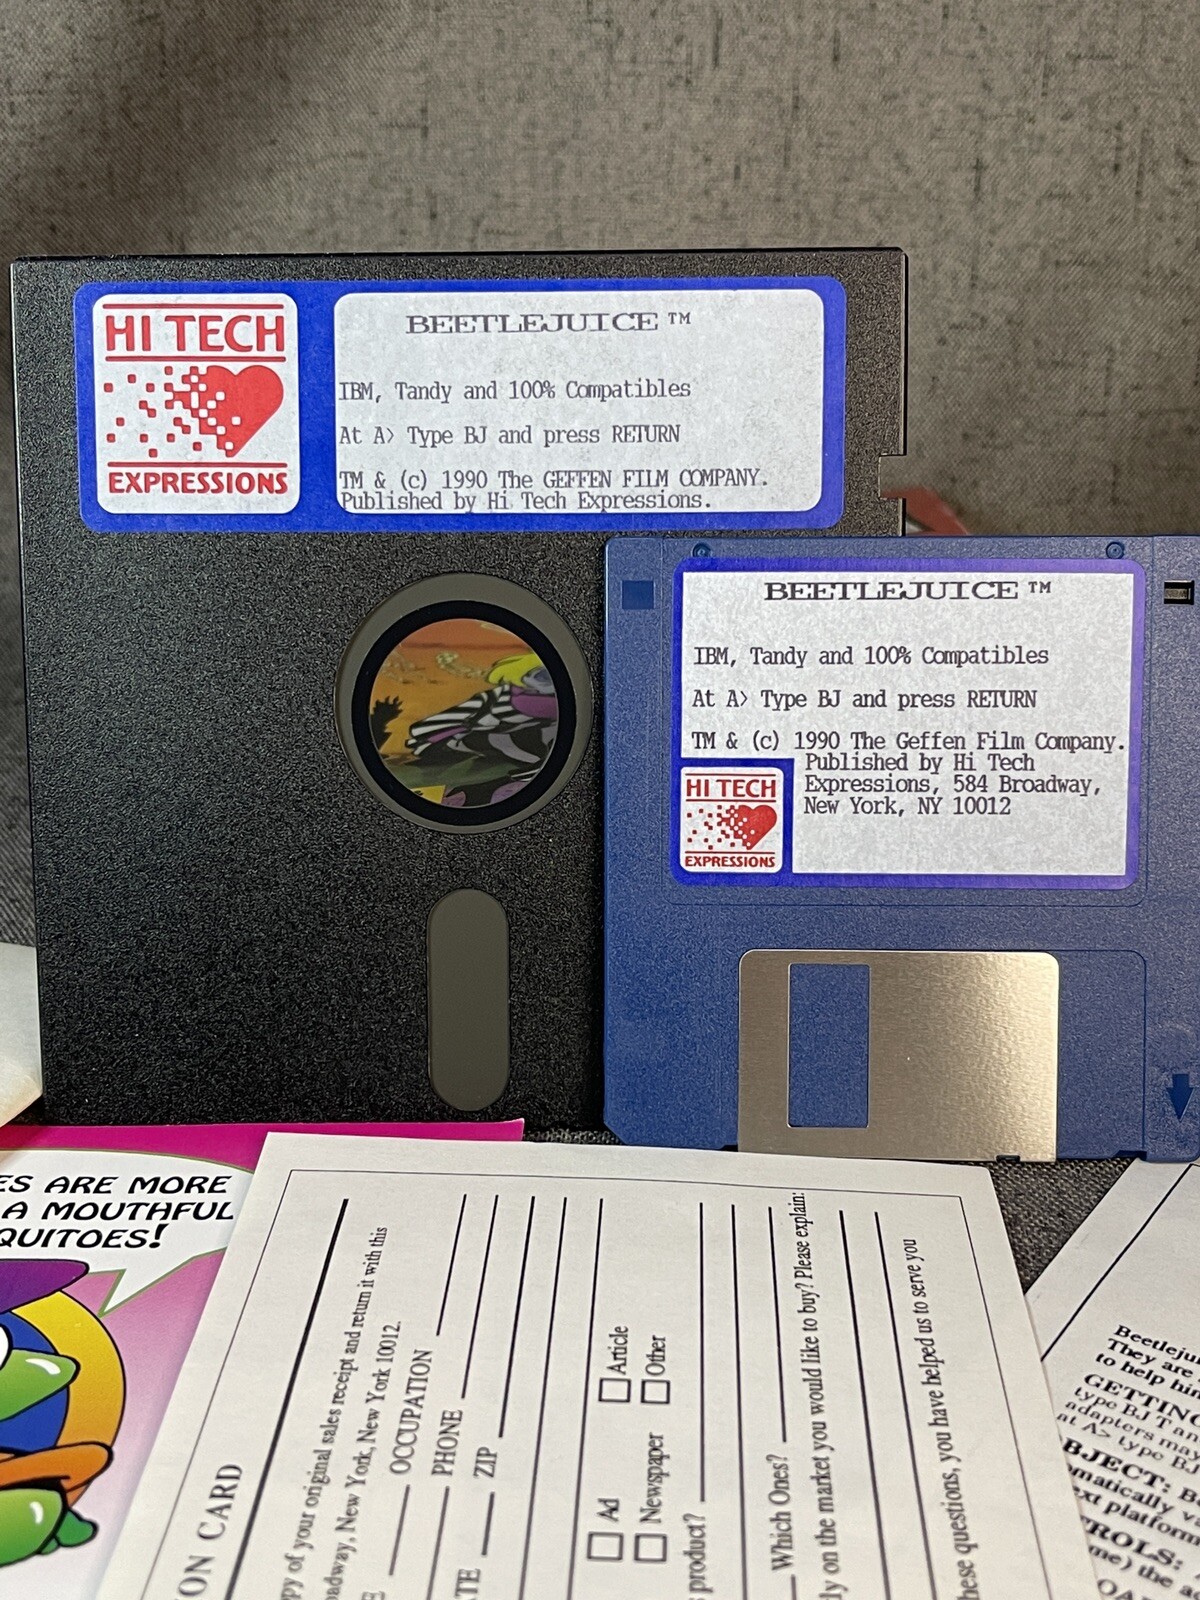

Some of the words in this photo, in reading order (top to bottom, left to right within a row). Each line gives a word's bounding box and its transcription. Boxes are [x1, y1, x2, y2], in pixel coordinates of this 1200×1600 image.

[106, 315, 151, 352] HI
[165, 314, 285, 352] TECH
[406, 313, 660, 334] BEETLEJUICE
[339, 382, 382, 404] IBM,
[395, 382, 452, 405] Tandy
[464, 381, 498, 401] and
[509, 380, 556, 400] 100%
[566, 378, 692, 403] Compatibles
[340, 426, 363, 446] At
[373, 426, 395, 445] A>
[407, 426, 454, 449] Type
[464, 425, 487, 445] BJ
[498, 425, 532, 444] and
[544, 427, 601, 448] press
[612, 424, 681, 443] RETURN
[108, 471, 288, 495] EXPRESSIONS
[340, 470, 364, 490] TM
[373, 471, 386, 490] &
[400, 469, 430, 492] (c)
[441, 469, 488, 490] 1990
[498, 469, 533, 489] The
[543, 469, 612, 489] GEFFEN
[622, 468, 669, 488] FILM
[679, 467, 769, 488] COMPANY.
[342, 491, 443, 511] Published
[454, 491, 475, 514] by
[487, 491, 513, 511] Hi
[521, 490, 567, 510] Tech
[577, 490, 712, 514] Expressions.
[764, 581, 1019, 601] BEETLEJUICE
[693, 647, 737, 668] IBM,
[750, 647, 808, 669] Tandy
[818, 646, 853, 666] and
[864, 646, 911, 666] 100%
[922, 645, 1049, 668] Compatibles
[692, 689, 716, 708] At
[726, 689, 749, 708] A>
[761, 689, 807, 711] Type
[818, 689, 842, 708] BJ
[852, 689, 887, 708] and
[897, 692, 955, 712] press
[967, 690, 1037, 708] RETURN
[692, 731, 716, 750] TM
[726, 731, 739, 750] &
[752, 730, 780, 752] (c)
[794, 731, 840, 750] 1990
[850, 731, 886, 750] The
[896, 731, 966, 750] Geffen
[977, 731, 1025, 750] Film
[1035, 732, 1126, 754] Company.
[805, 753, 908, 772] Published
[919, 753, 943, 775] by
[953, 753, 977, 772] Hi
[988, 753, 1036, 772] Tech
[685, 779, 710, 798] HI
[717, 779, 777, 798] TECH
[804, 774, 939, 796] Expressions,
[953, 775, 988, 793] 584
[999, 774, 1101, 797] Broadway,
[803, 796, 839, 816] New
[850, 796, 904, 818] York,
[917, 796, 943, 816] NY
[953, 796, 1012, 816] 10012
[684, 855, 776, 869] EXPRESSIONS
[44, 1176, 119, 1195] ARE
[128, 1175, 233, 1195] MORE
[1, 1201, 29, 1220] A
[41, 1201, 235, 1221] MOUTHFUL
[787, 1192, 814, 1238] explain:
[368, 1225, 388, 1248] this
[903, 1238, 926, 1266] you
[363, 1250, 384, 1277] with
[793, 1241, 814, 1279] Please
[357, 1277, 374, 1290] it
[794, 1282, 821, 1314] buy?
[906, 1266, 928, 1298] serve
[351, 1289, 373, 1330] return
[802, 1317, 818, 1332] to
[913, 1301, 928, 1317] to
[917, 1317, 933, 1334] us
[343, 1330, 362, 1355] and
[376, 1320, 402, 1364] 10012.
[606, 1325, 630, 1375] Article
[645, 1334, 667, 1377] Other
[800, 1336, 820, 1364] like
[1107, 1338, 1157, 1365] They
[1161, 1361, 1194, 1378] are
[914, 1337, 945, 1386] helped
[1095, 1352, 1116, 1367] to
[1120, 1361, 1166, 1386] help
[331, 1357, 360, 1407] receipt
[365, 1367, 392, 1406] York
[801, 1367, 826, 1414] would
[389, 1348, 433, 1475] OCCUPATION
[926, 1389, 950, 1428] have
[1065, 1401, 1155, 1441] adapters
[1074, 1386, 1117, 1410] type
[1122, 1403, 1151, 1421] BJ
[1155, 1414, 1173, 1430] T
[319, 1408, 343, 1446] sales
[357, 1407, 382, 1444] New
[811, 1420, 836, 1452] you
[431, 1409, 464, 1477] PHONE
[936, 1433, 962, 1463] you
[1056, 1412, 1077, 1426] at
[1118, 1435, 1164, 1460] type
[1171, 1455, 1200, 1474] BJ
[303, 1449, 332, 1508] original
[345, 1446, 377, 1489] York,
[640, 1432, 671, 1524] Newspaper
[765, 1454, 791, 1506] Ones?
[810, 1456, 834, 1513] market
[334, 1493, 361, 1532] New
[454, 1568, 481, 1600] TE
[473, 1446, 498, 1479] ZIP
[597, 1498, 619, 1522] Ad
[939, 1468, 979, 1554] questions,
[174, 1555, 216, 1600] ON
[197, 1464, 244, 1540] CARD
[293, 1511, 316, 1550] your
[769, 1511, 793, 1571] Which
[814, 1518, 837, 1546] the
[284, 1552, 306, 1573] of
[682, 1513, 714, 1593] product?
[822, 1551, 840, 1575] on
[280, 1577, 304, 1600] py
[818, 1580, 848, 1600] ly
[1137, 1564, 1174, 1589] the
